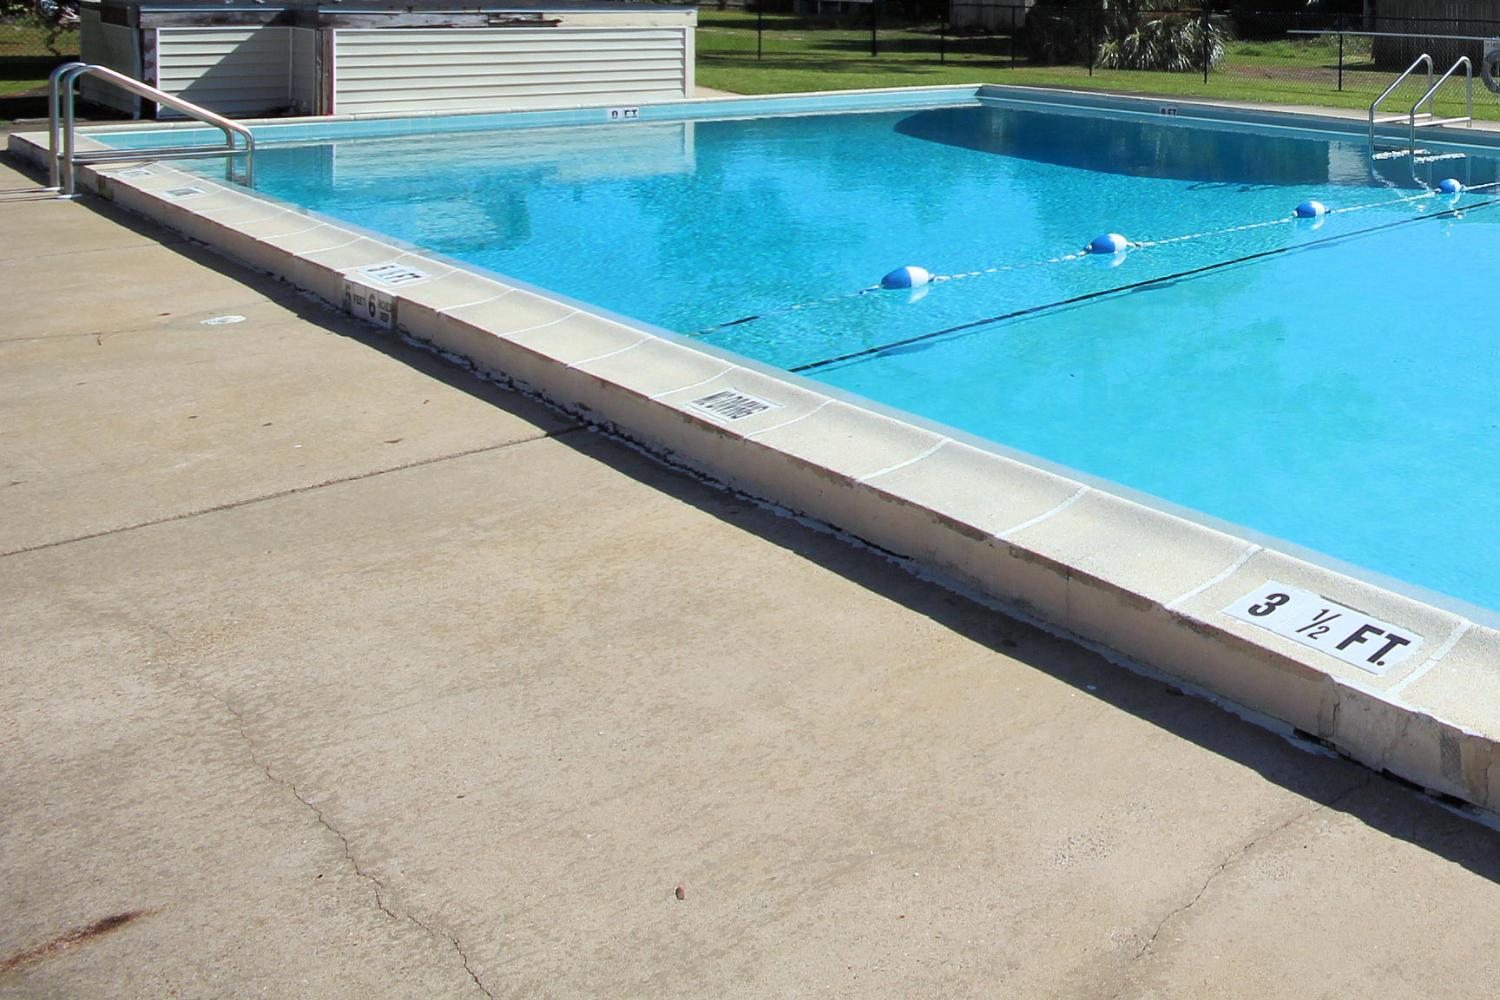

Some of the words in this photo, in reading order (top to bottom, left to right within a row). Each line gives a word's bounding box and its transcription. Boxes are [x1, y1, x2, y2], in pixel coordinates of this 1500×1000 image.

[368, 294, 375, 317] 6
[1248, 593, 1290, 617] 3
[1335, 623, 1412, 667] FT.
